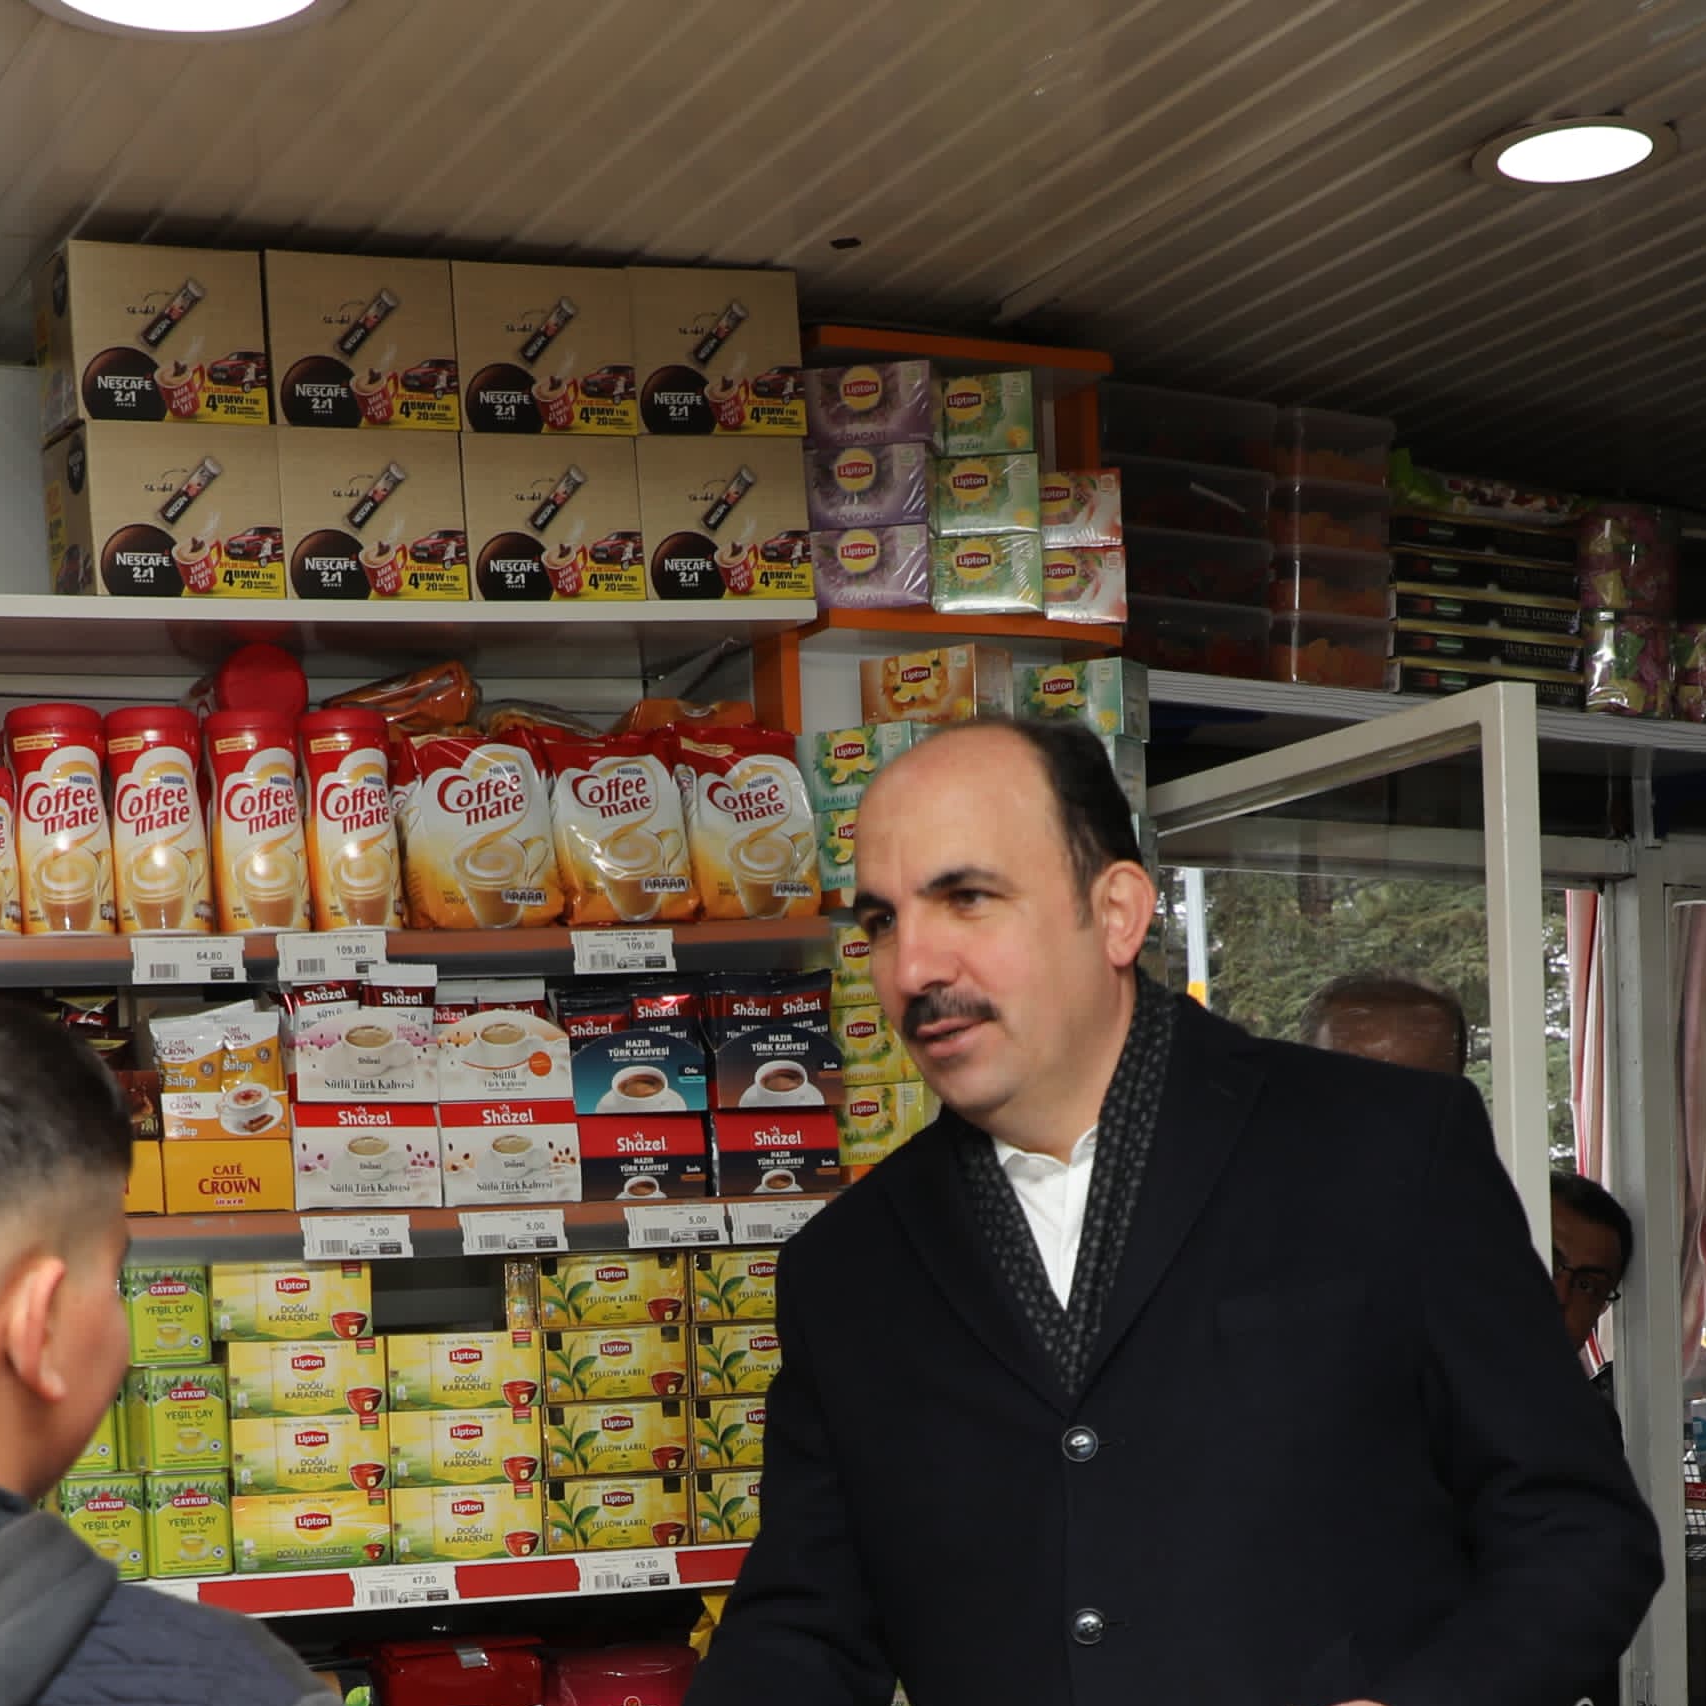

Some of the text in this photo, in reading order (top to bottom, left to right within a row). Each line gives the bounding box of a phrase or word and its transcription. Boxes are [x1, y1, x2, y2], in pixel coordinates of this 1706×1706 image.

[954, 475, 986, 486] Lipton
[958, 554, 989, 566] Lipton
[437, 773, 523, 813] Coffee
[572, 774, 648, 810] Coffee
[707, 781, 779, 811] Coffee
[23, 783, 97, 823] Coffee
[116, 783, 190, 824] Coffee
[465, 791, 525, 826] mate
[599, 792, 652, 819] mate
[248, 805, 297, 834] mate
[735, 799, 785, 824] mate
[43, 807, 100, 836] mate
[609, 1048, 633, 1057] TÜRK
[223, 1058, 253, 1072] Salep
[165, 1075, 197, 1089] Salep
[324, 1078, 414, 1090] Sütlü Türk Kahvesi
[338, 1104, 391, 1125] Shazel
[482, 1104, 534, 1123] Shazel
[212, 1164, 243, 1176] CAFÉ
[198, 1178, 261, 1194] CROWN
[278, 1281, 307, 1292] Lipton
[585, 1294, 642, 1305] YELLOW LABEL
[174, 1302, 195, 1318] ÇAY
[280, 1305, 308, 1314] DOĞU
[294, 1358, 323, 1369] Lipton
[589, 1368, 645, 1378] YELLOW LABEL
